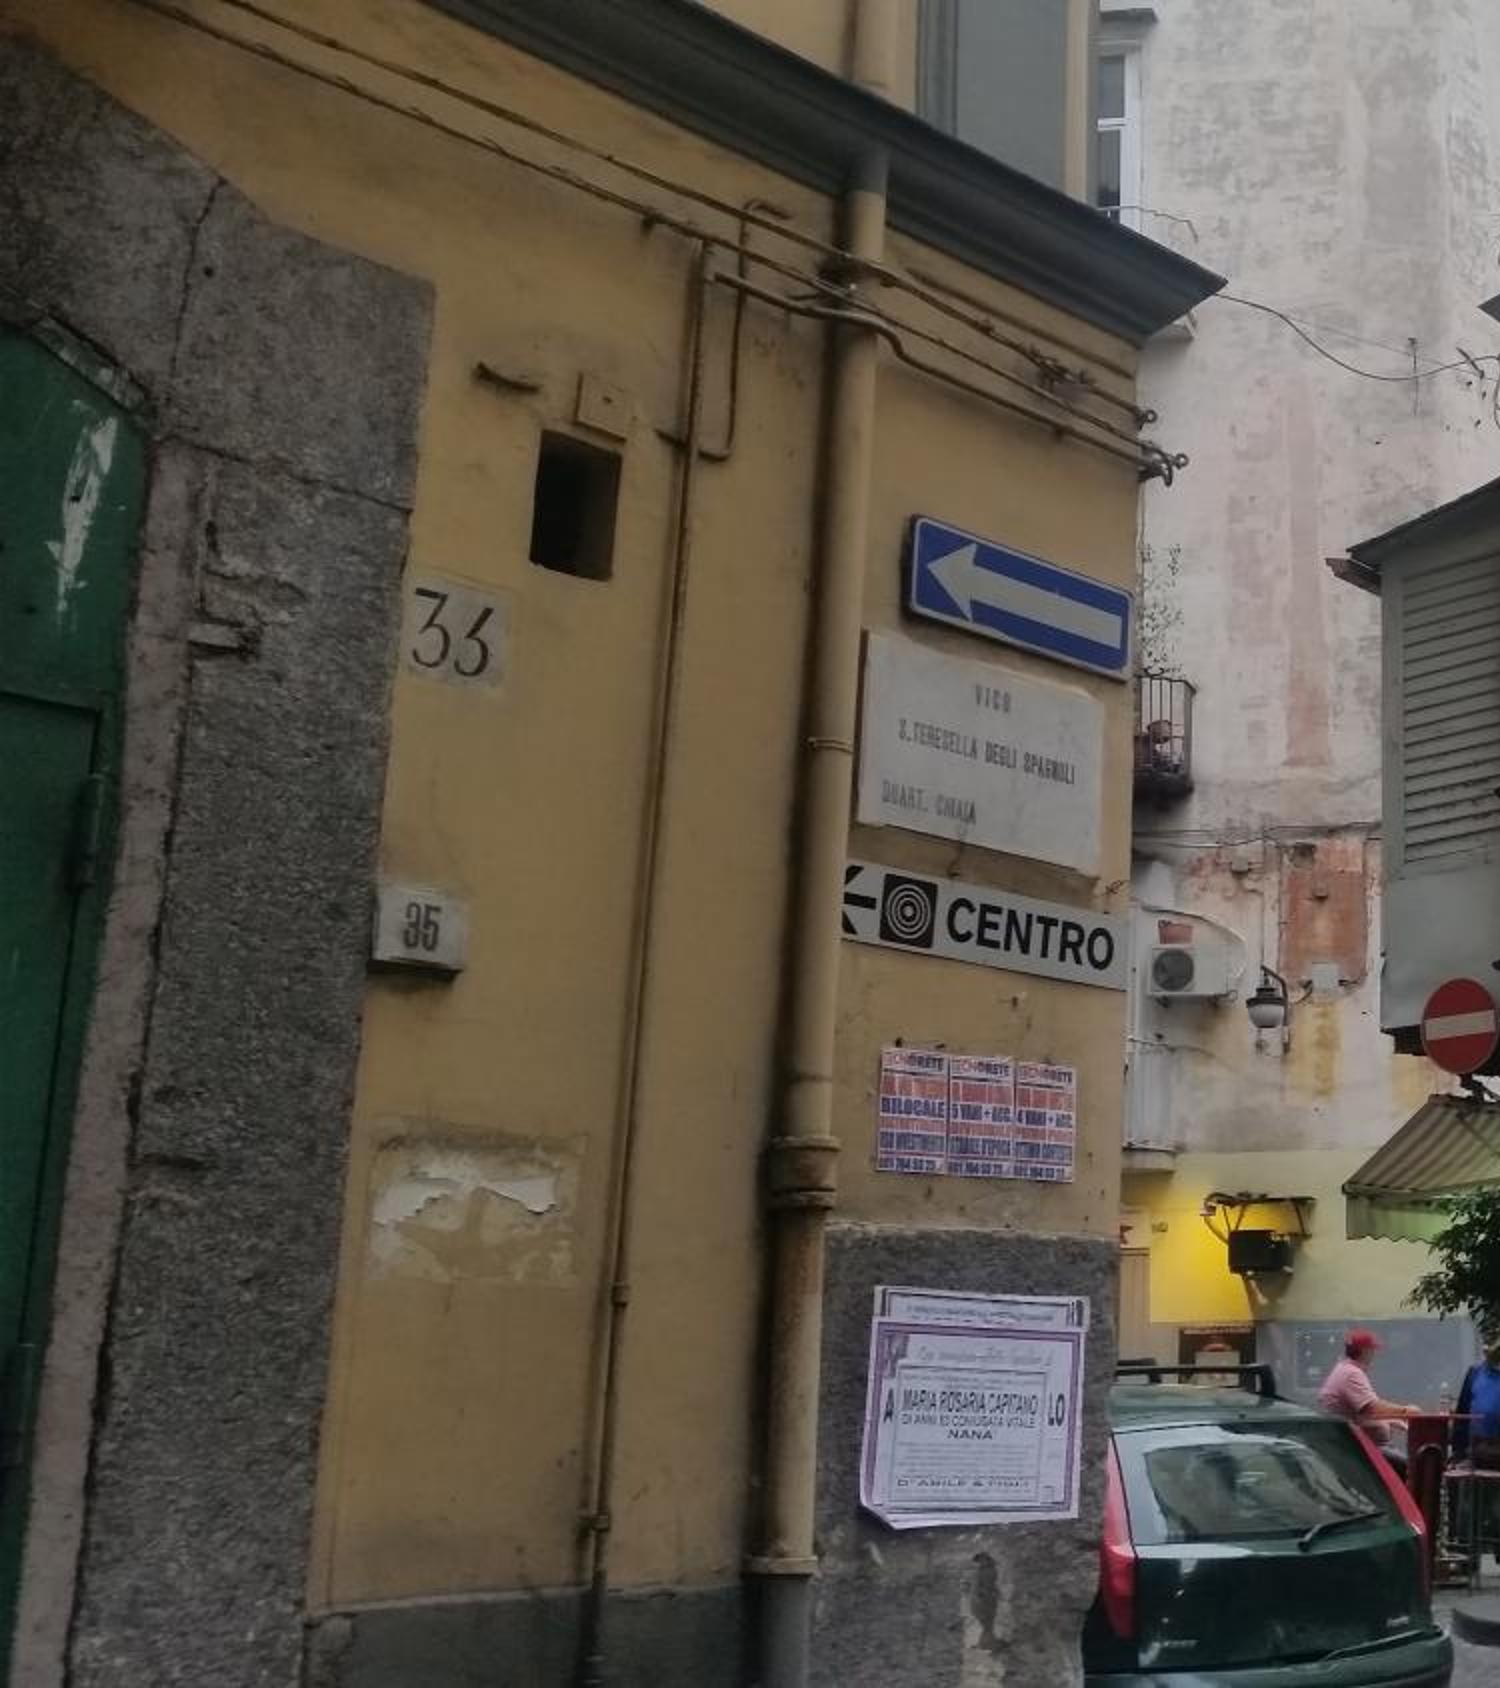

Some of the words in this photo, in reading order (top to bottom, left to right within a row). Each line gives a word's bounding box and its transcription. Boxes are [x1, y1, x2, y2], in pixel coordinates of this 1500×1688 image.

[975, 683, 1012, 714] VICO
[985, 740, 1017, 769] DEGLI
[1023, 751, 1076, 785] SPAGNOLI
[403, 902, 443, 952] 35
[946, 896, 1115, 971] CENTRO
[880, 1096, 945, 1118] BILOCALE
[903, 1388, 937, 1411] MARIA
[939, 1390, 985, 1413] ROSARIA
